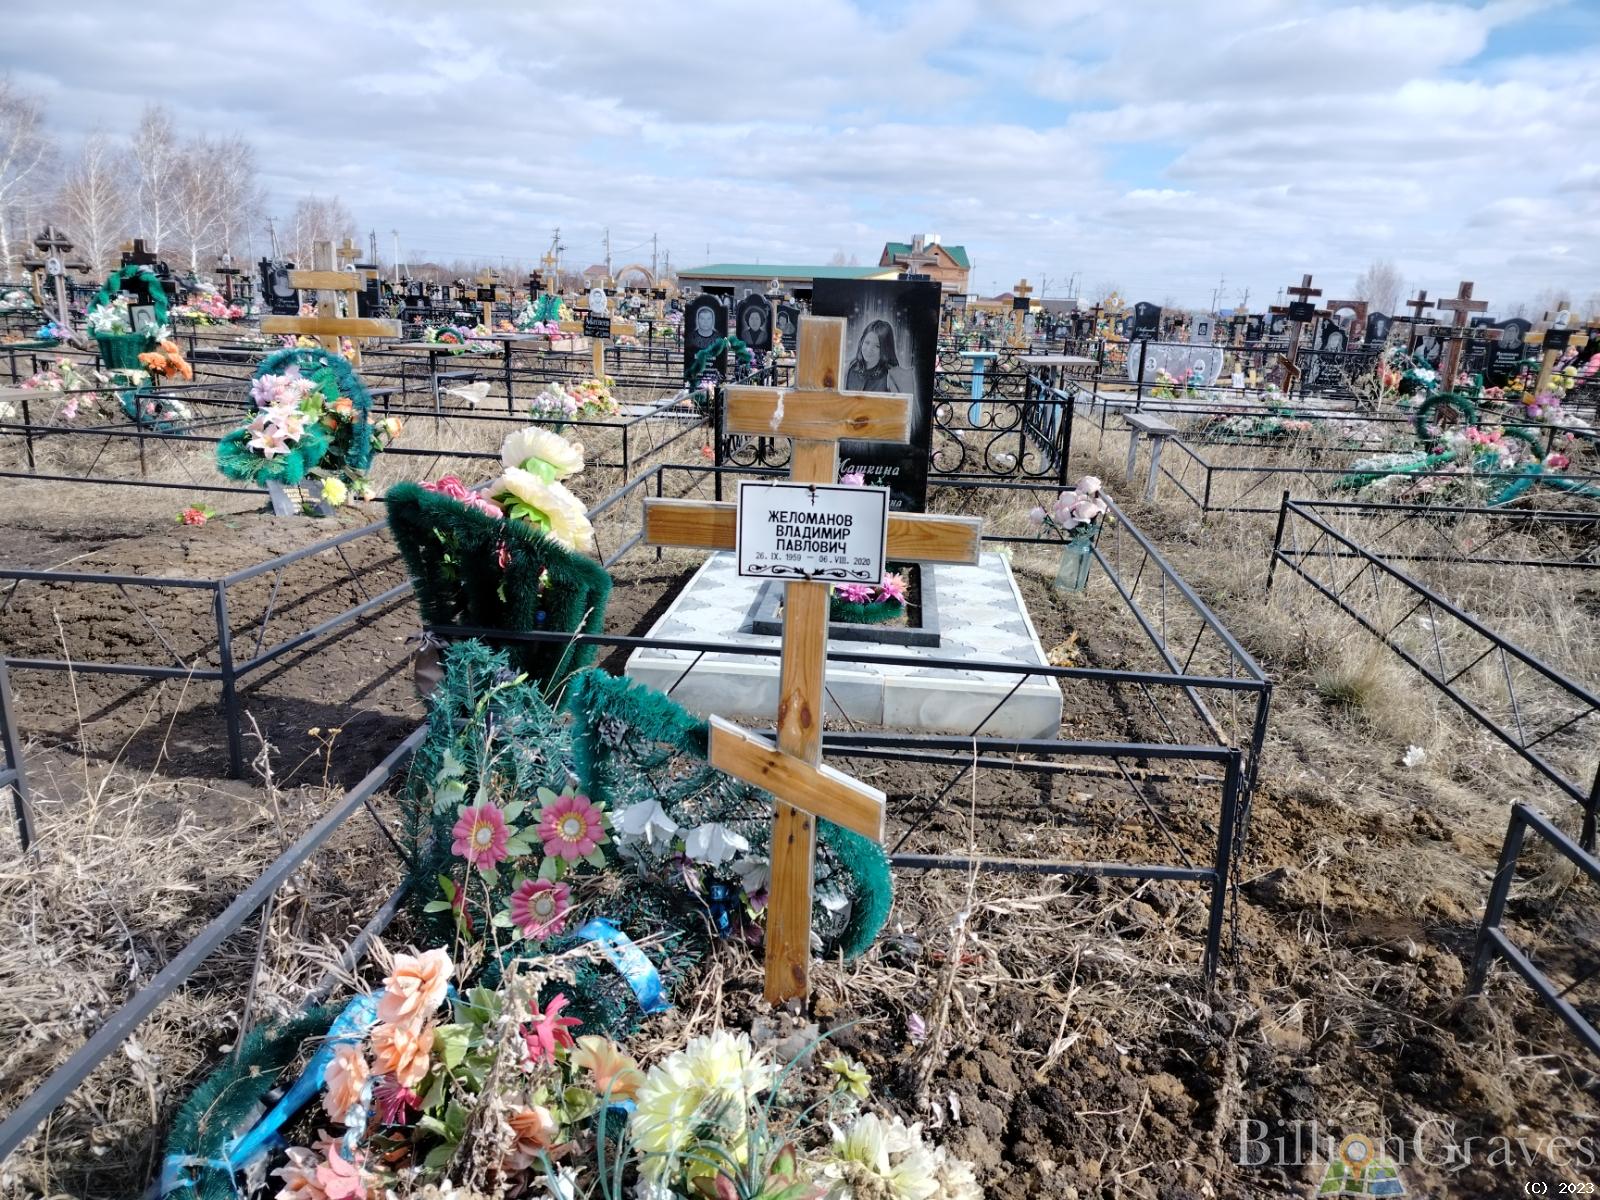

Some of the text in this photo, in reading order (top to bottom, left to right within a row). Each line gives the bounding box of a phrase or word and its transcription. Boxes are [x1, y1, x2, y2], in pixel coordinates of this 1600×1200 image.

[768, 510, 853, 526] ЖЕЛОМАНОВ
[776, 525, 851, 540] ВЛАДИМИР
[776, 539, 847, 554] ПАВЛОВИЧ
[755, 552, 768, 560] 26.
[771, 552, 782, 561] IX.
[818, 555, 832, 563] 06.
[834, 556, 849, 565] VIII.
[853, 557, 871, 566] 2020
